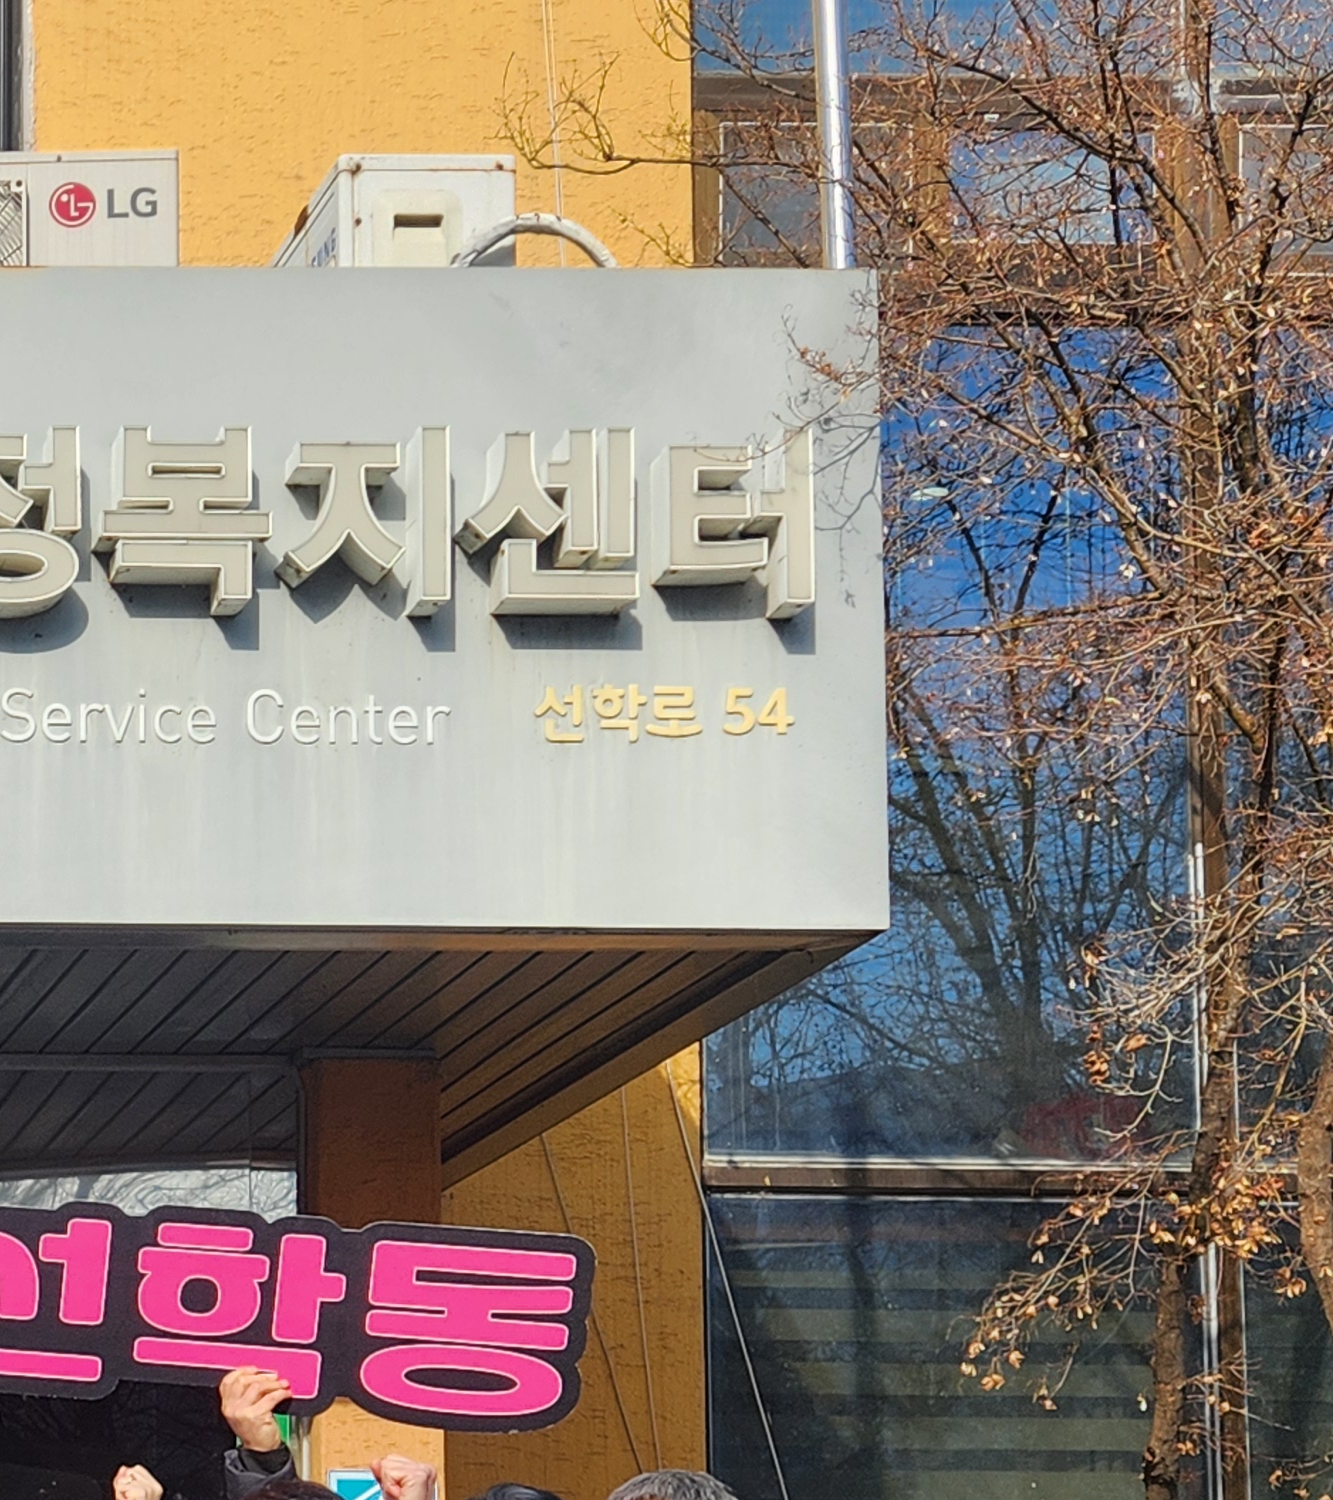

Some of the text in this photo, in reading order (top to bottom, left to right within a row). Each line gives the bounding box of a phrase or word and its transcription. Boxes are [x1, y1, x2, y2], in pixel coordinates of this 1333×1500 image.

[106, 186, 158, 220] LG
[0, 686, 217, 745] Service
[244, 688, 450, 745] Center
[533, 684, 794, 743] 선학로 54
